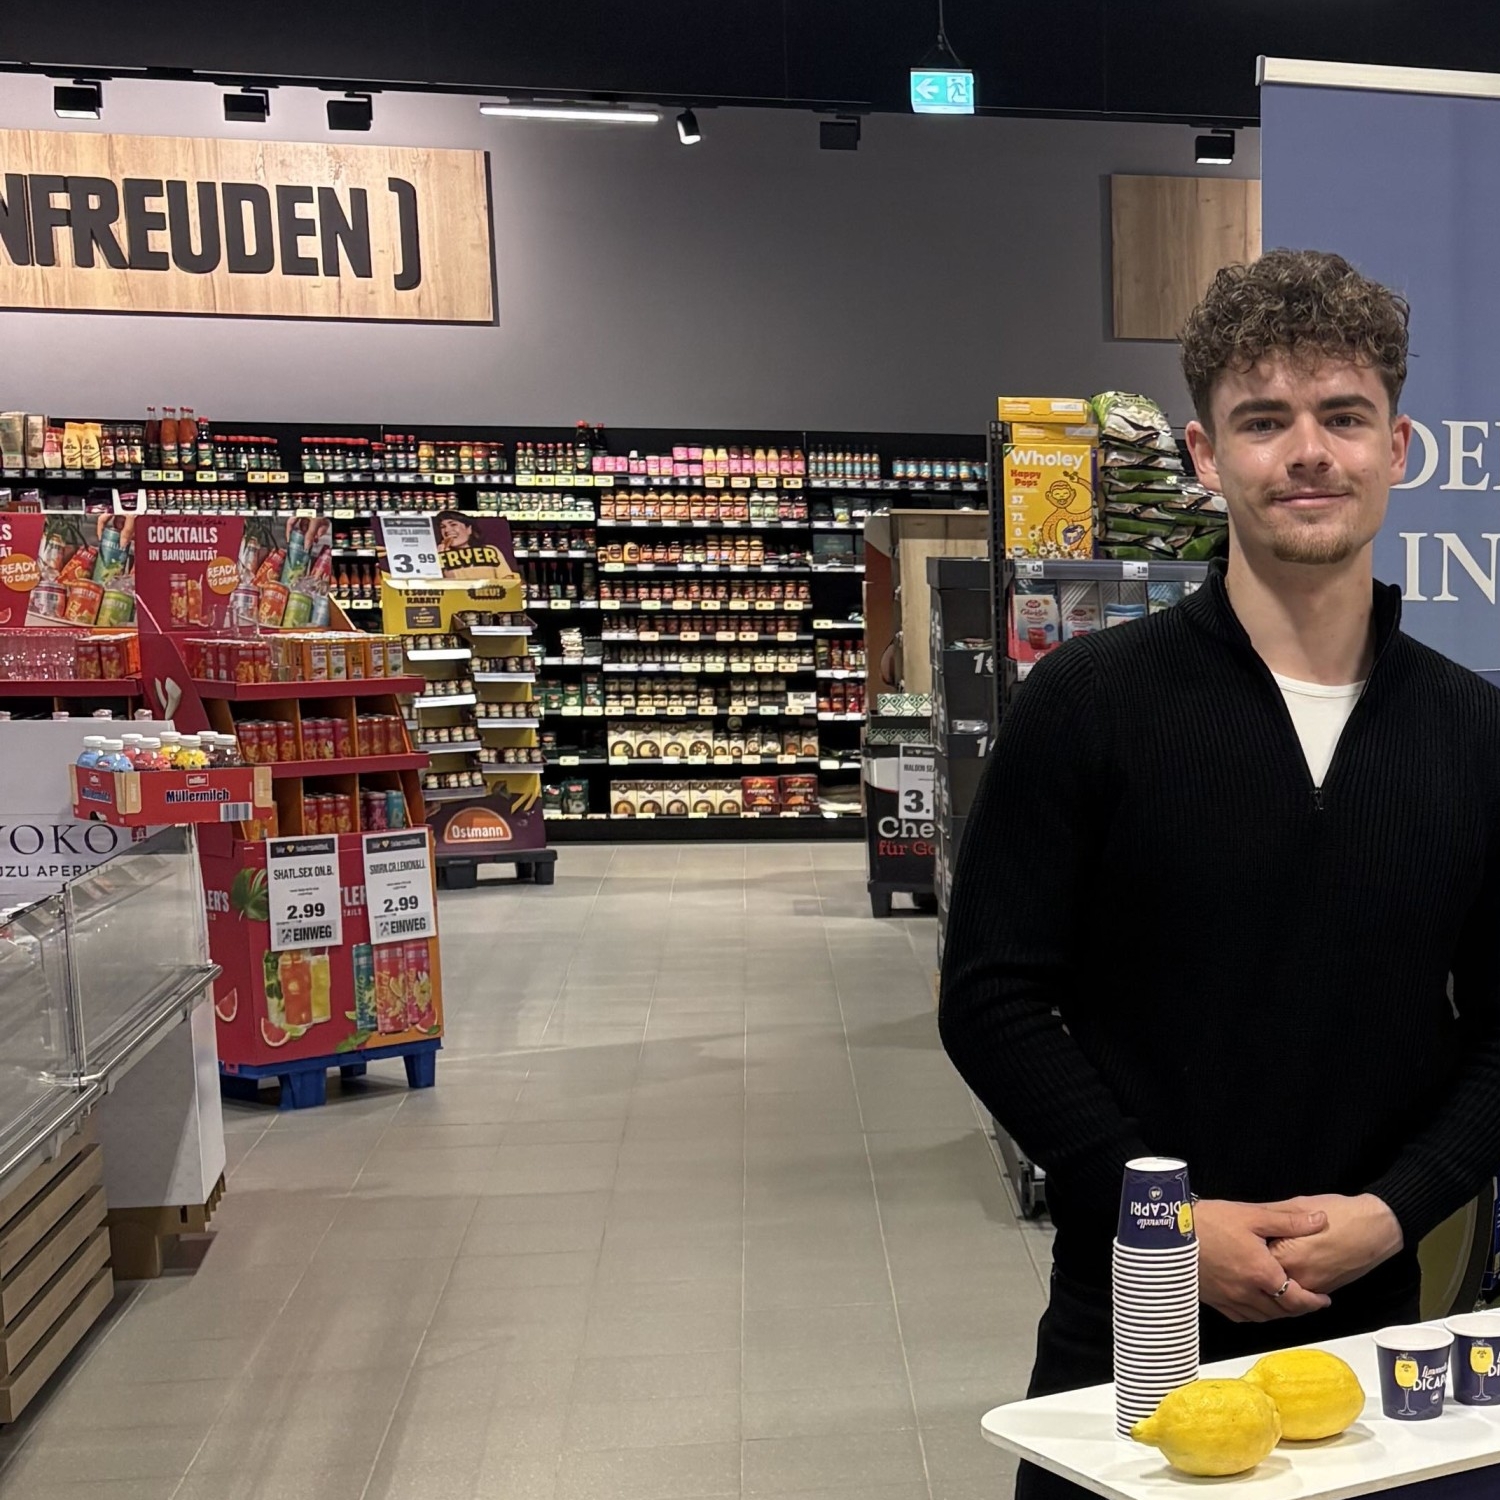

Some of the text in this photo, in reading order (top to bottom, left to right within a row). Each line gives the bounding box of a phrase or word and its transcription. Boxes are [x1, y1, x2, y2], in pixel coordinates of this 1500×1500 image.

[1011, 450, 1083, 469] Wholey
[1014, 478, 1038, 488] Pops
[148, 526, 218, 543] COCKTAILS
[149, 549, 160, 561] IN
[393, 552, 437, 574] 3.99
[438, 547, 500, 568] FRYER
[2, 561, 37, 575] READY
[207, 563, 238, 578] READY
[166, 788, 229, 803] Müllermilch
[452, 825, 504, 838] Ostmann
[287, 902, 325, 920] 2.99
[384, 895, 418, 913] 2.99
[293, 925, 332, 941] EINWEG
[390, 917, 427, 934] EINWEG
[1130, 1200, 1181, 1217] DICAPRI
